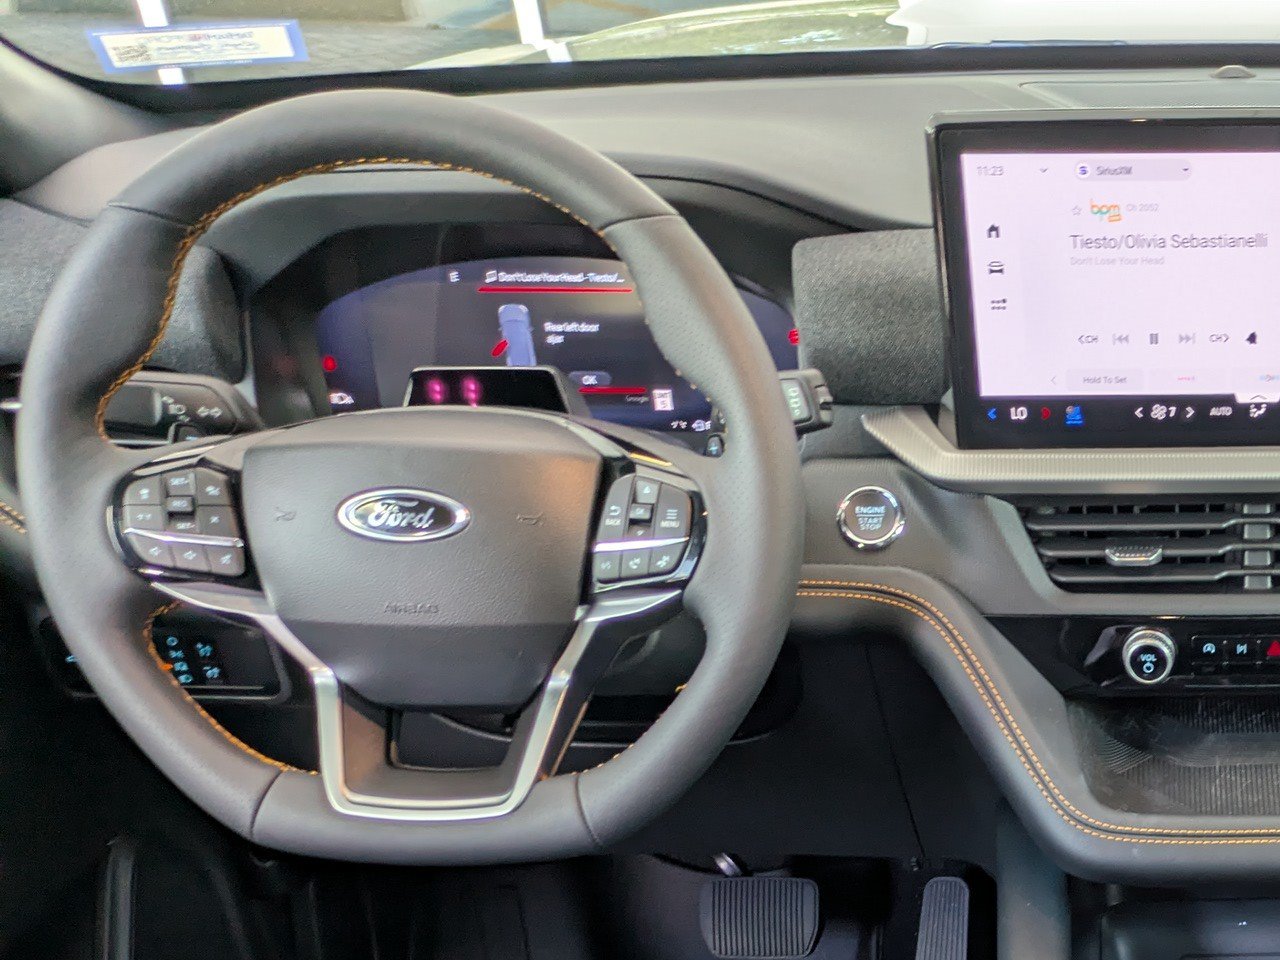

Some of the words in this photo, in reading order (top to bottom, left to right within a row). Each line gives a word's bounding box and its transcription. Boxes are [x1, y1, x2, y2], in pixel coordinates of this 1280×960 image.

[1070, 234, 1166, 250] Tiesto/Olivia
[1171, 233, 1268, 249] Sebastianelli
[1210, 407, 1233, 417] AUTO
[367, 500, 435, 529] Ford
[855, 505, 885, 514] ENGINE
[1140, 653, 1157, 661] VOL
